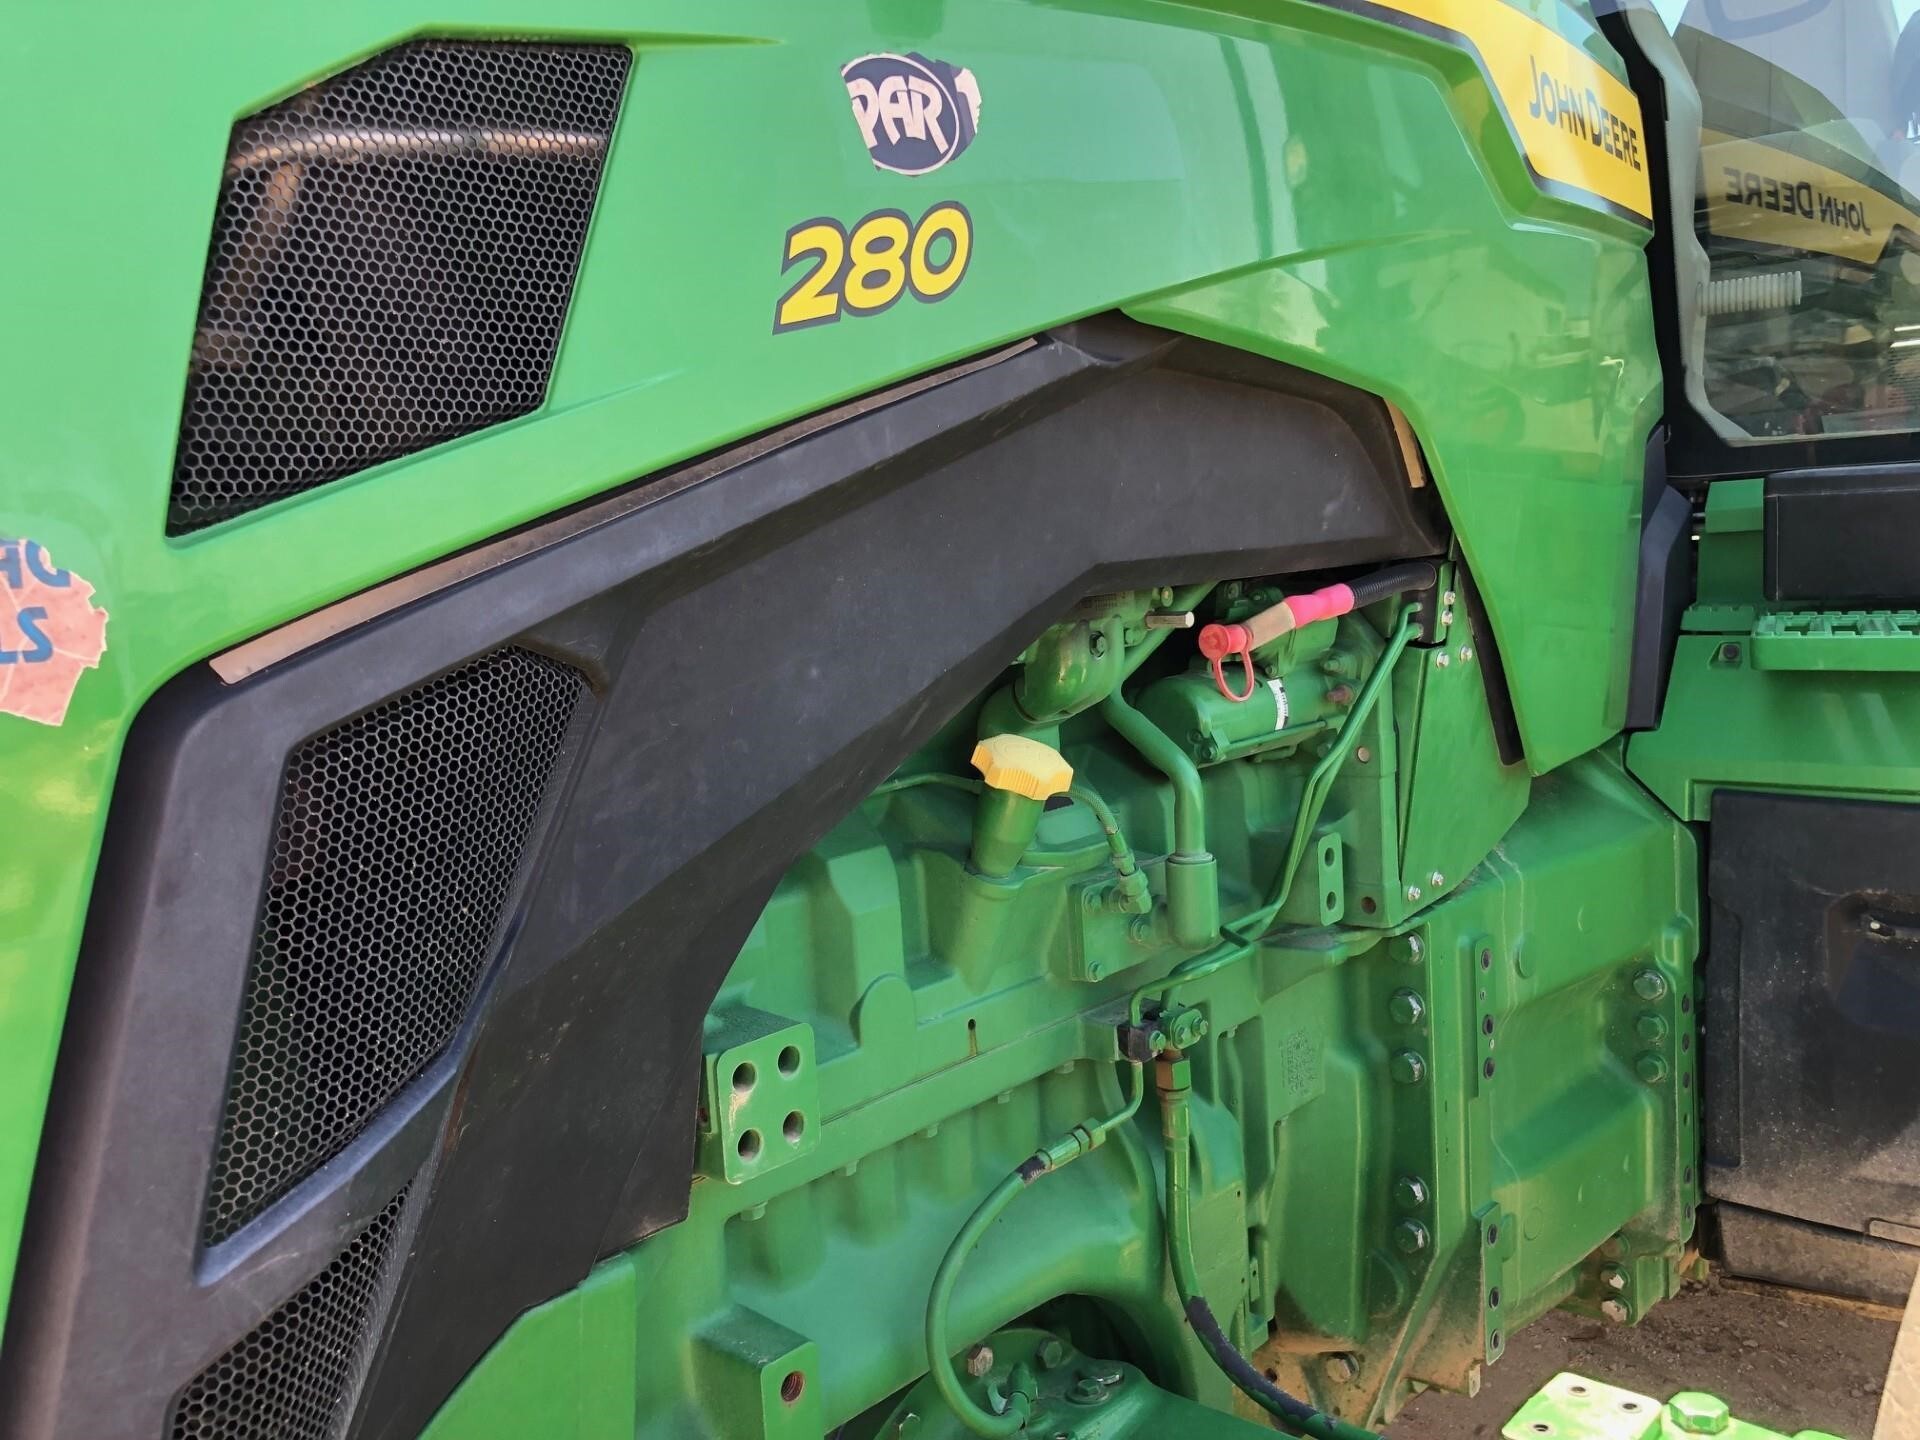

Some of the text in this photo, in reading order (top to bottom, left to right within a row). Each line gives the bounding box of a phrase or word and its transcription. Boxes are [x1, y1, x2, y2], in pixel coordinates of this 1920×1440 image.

[1529, 54, 1641, 172] JOHN DEERE
[772, 201, 973, 335] 280
